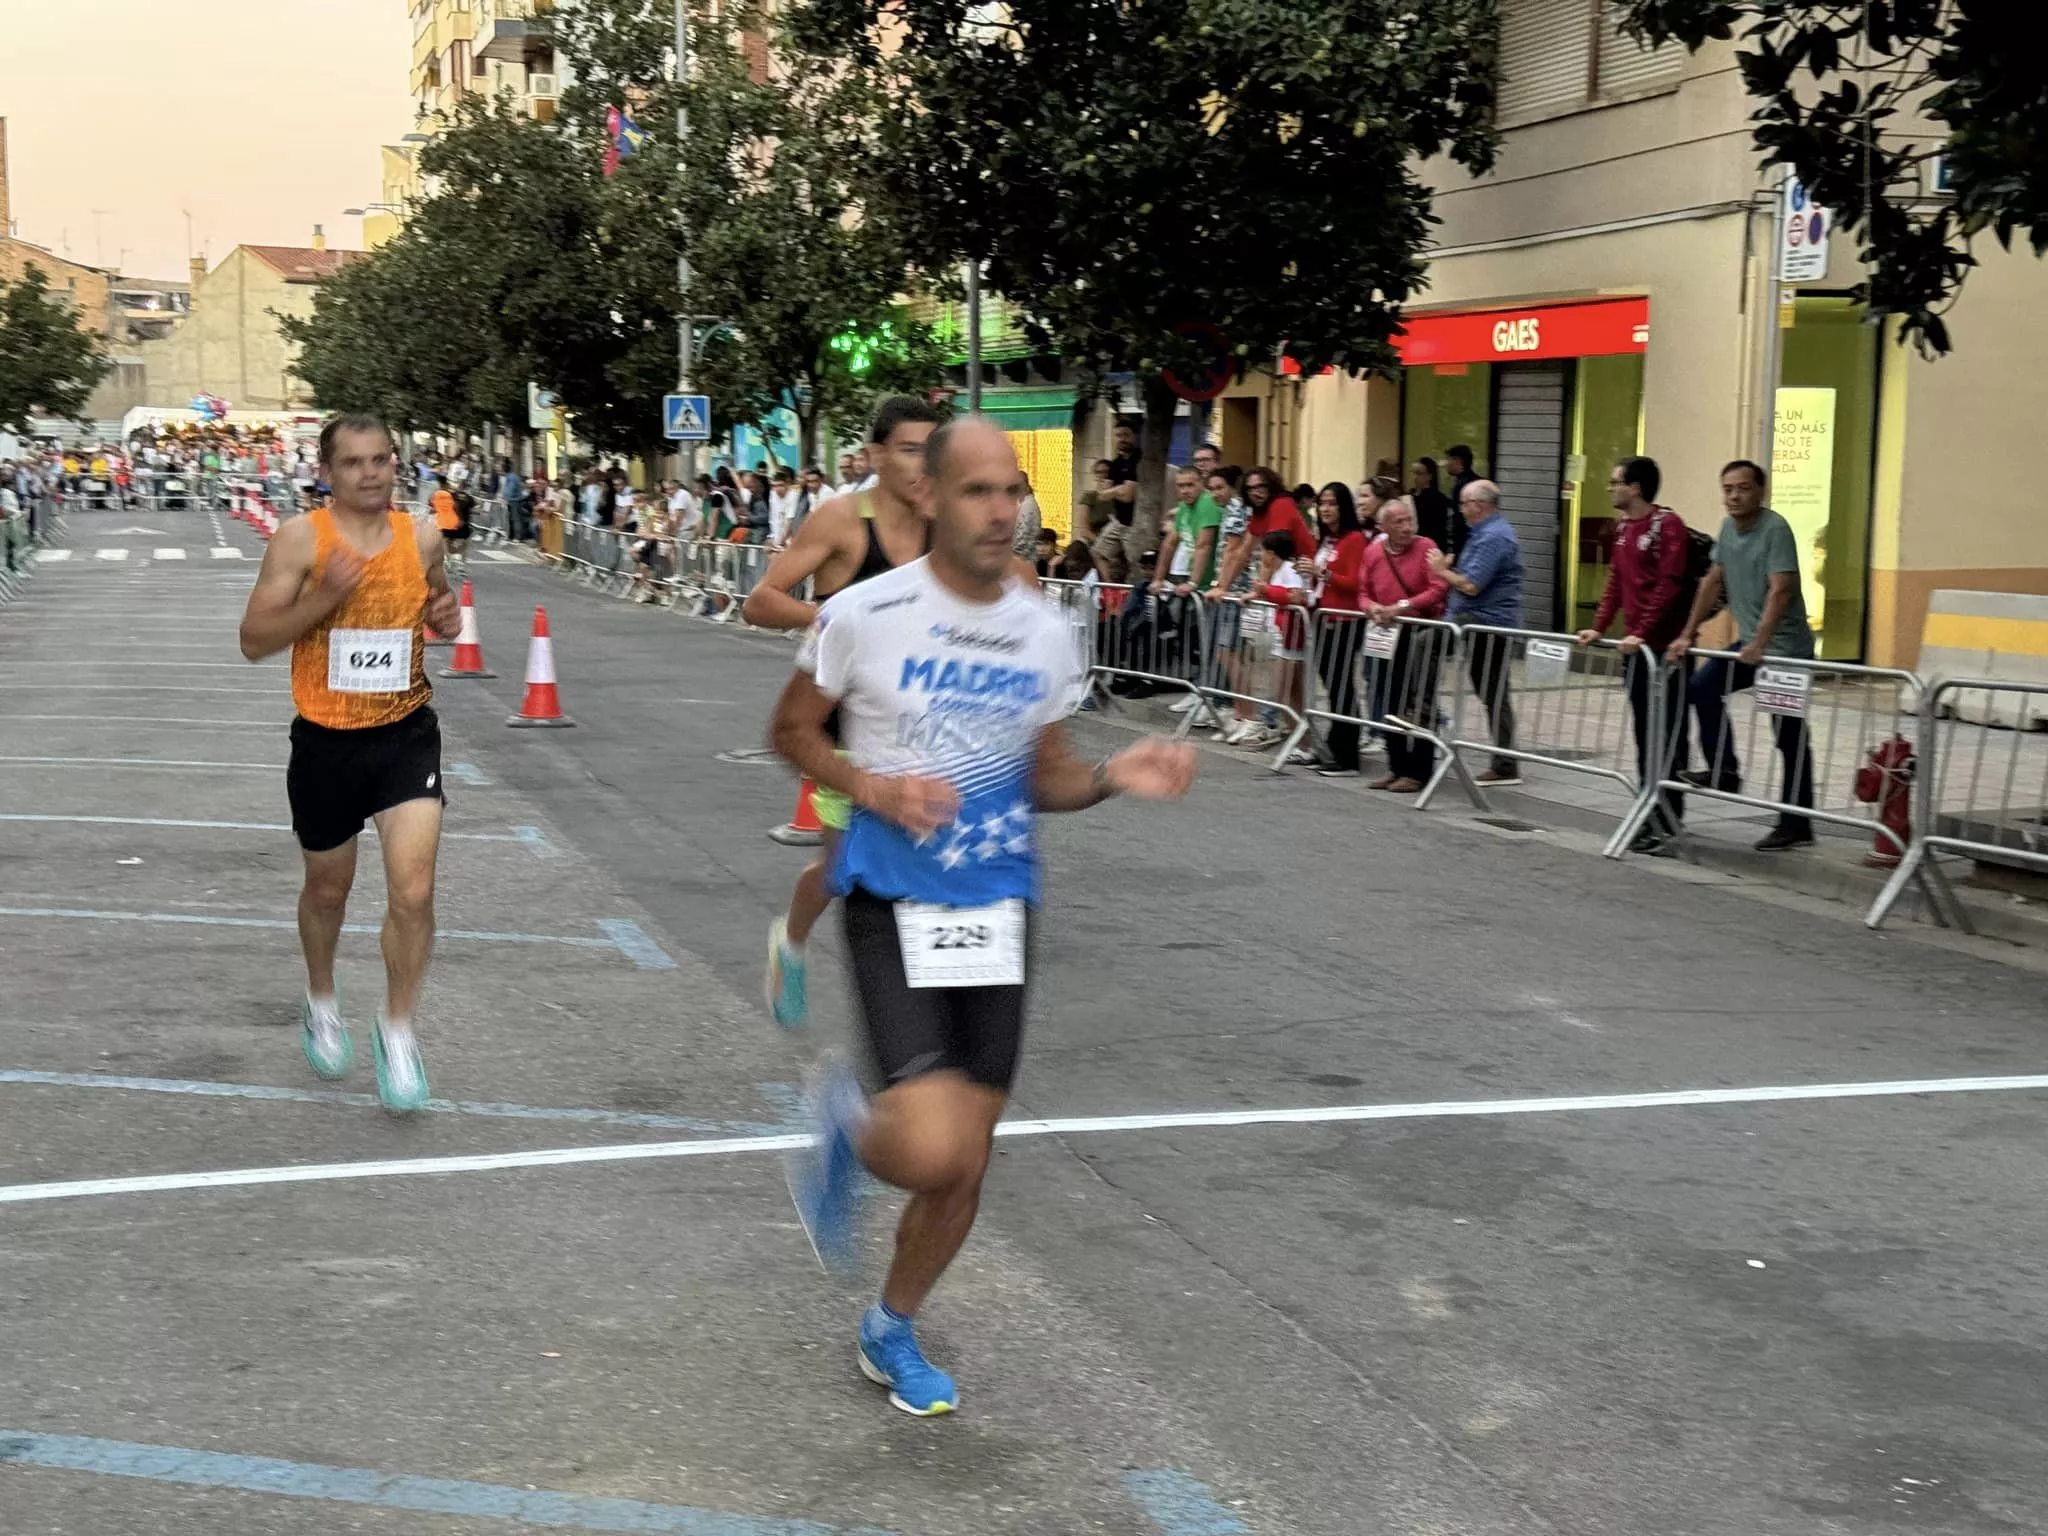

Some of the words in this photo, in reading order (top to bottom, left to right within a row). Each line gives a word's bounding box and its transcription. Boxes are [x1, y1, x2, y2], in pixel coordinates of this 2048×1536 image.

[1493, 317, 1541, 352] GAES
[1787, 409, 1804, 421] UN
[1800, 419, 1827, 434] MÁS
[1800, 436, 1813, 448] TE
[350, 651, 393, 669] 624
